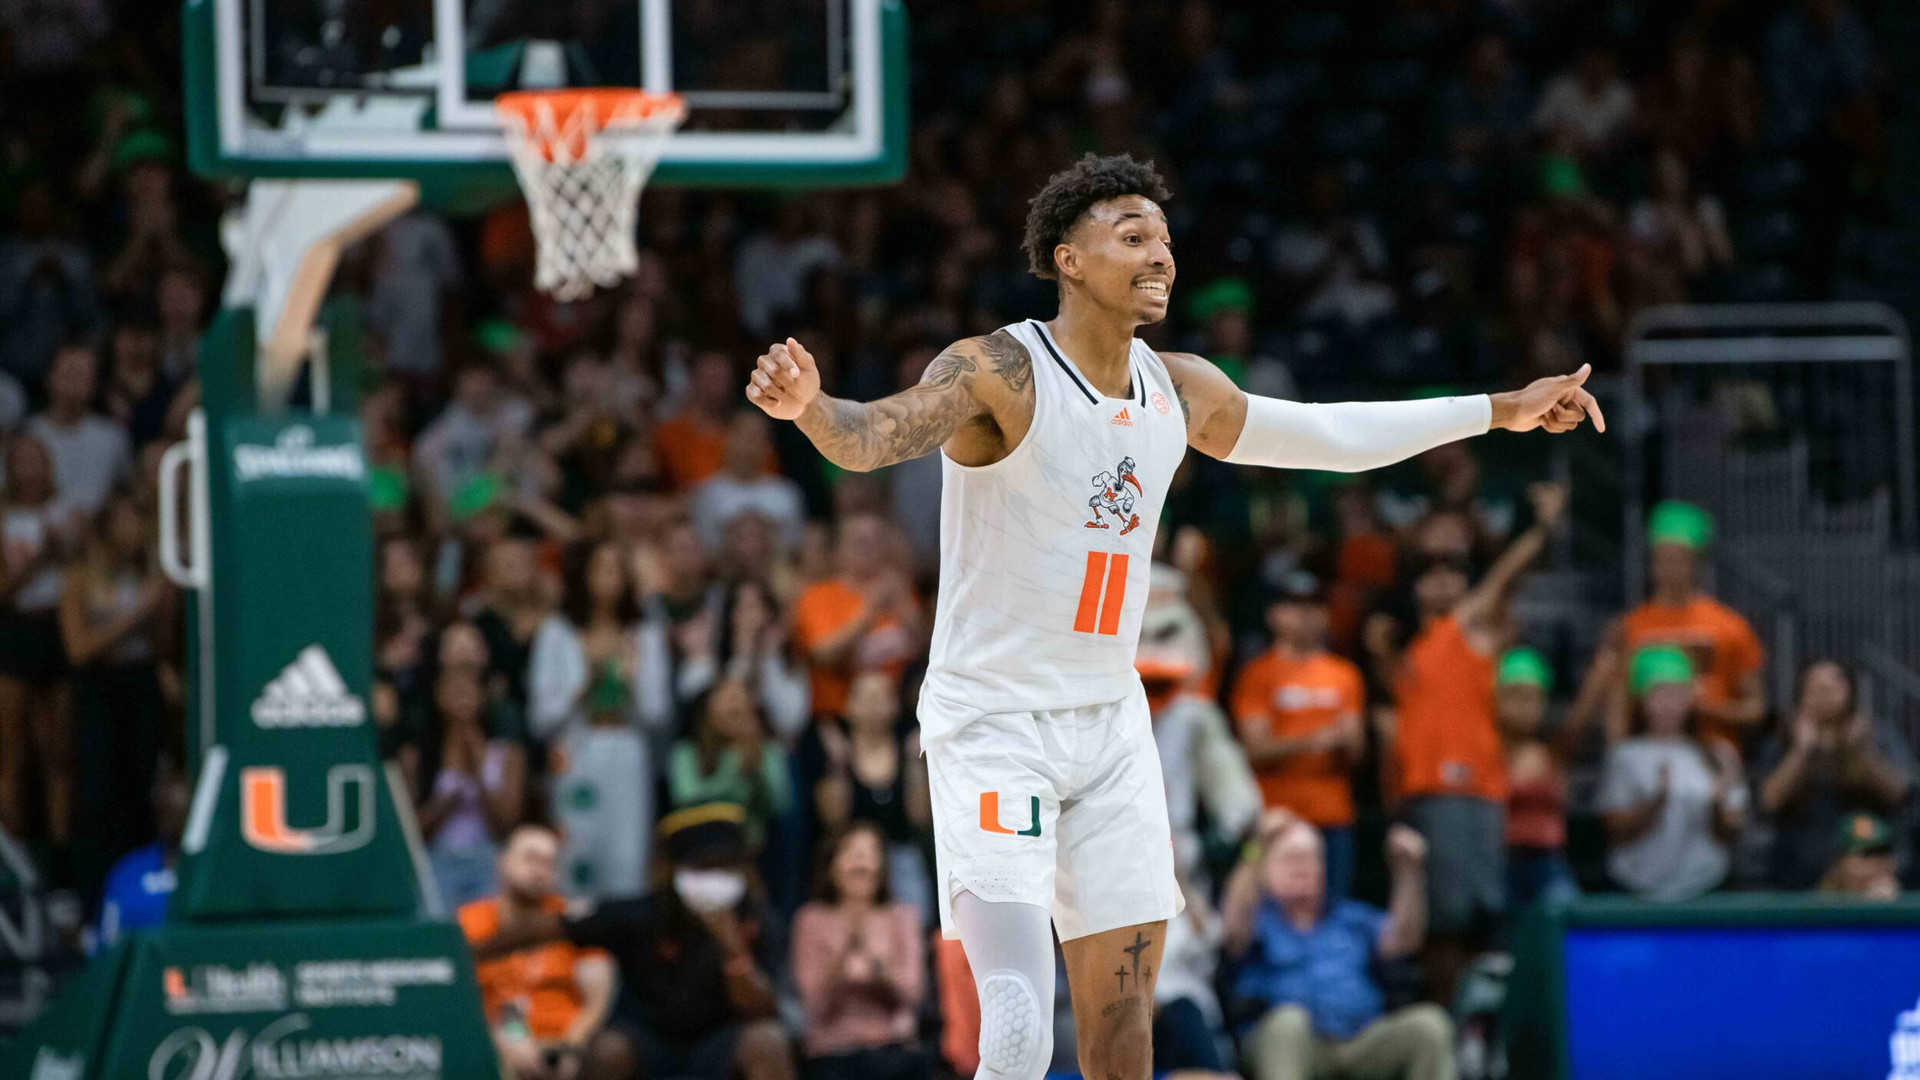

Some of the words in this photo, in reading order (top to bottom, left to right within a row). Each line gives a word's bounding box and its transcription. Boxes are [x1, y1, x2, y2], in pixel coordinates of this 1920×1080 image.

[1110, 418, 1134, 428] adidas
[1073, 551, 1129, 635] 11
[240, 764, 375, 854] U
[980, 791, 1041, 837] U
